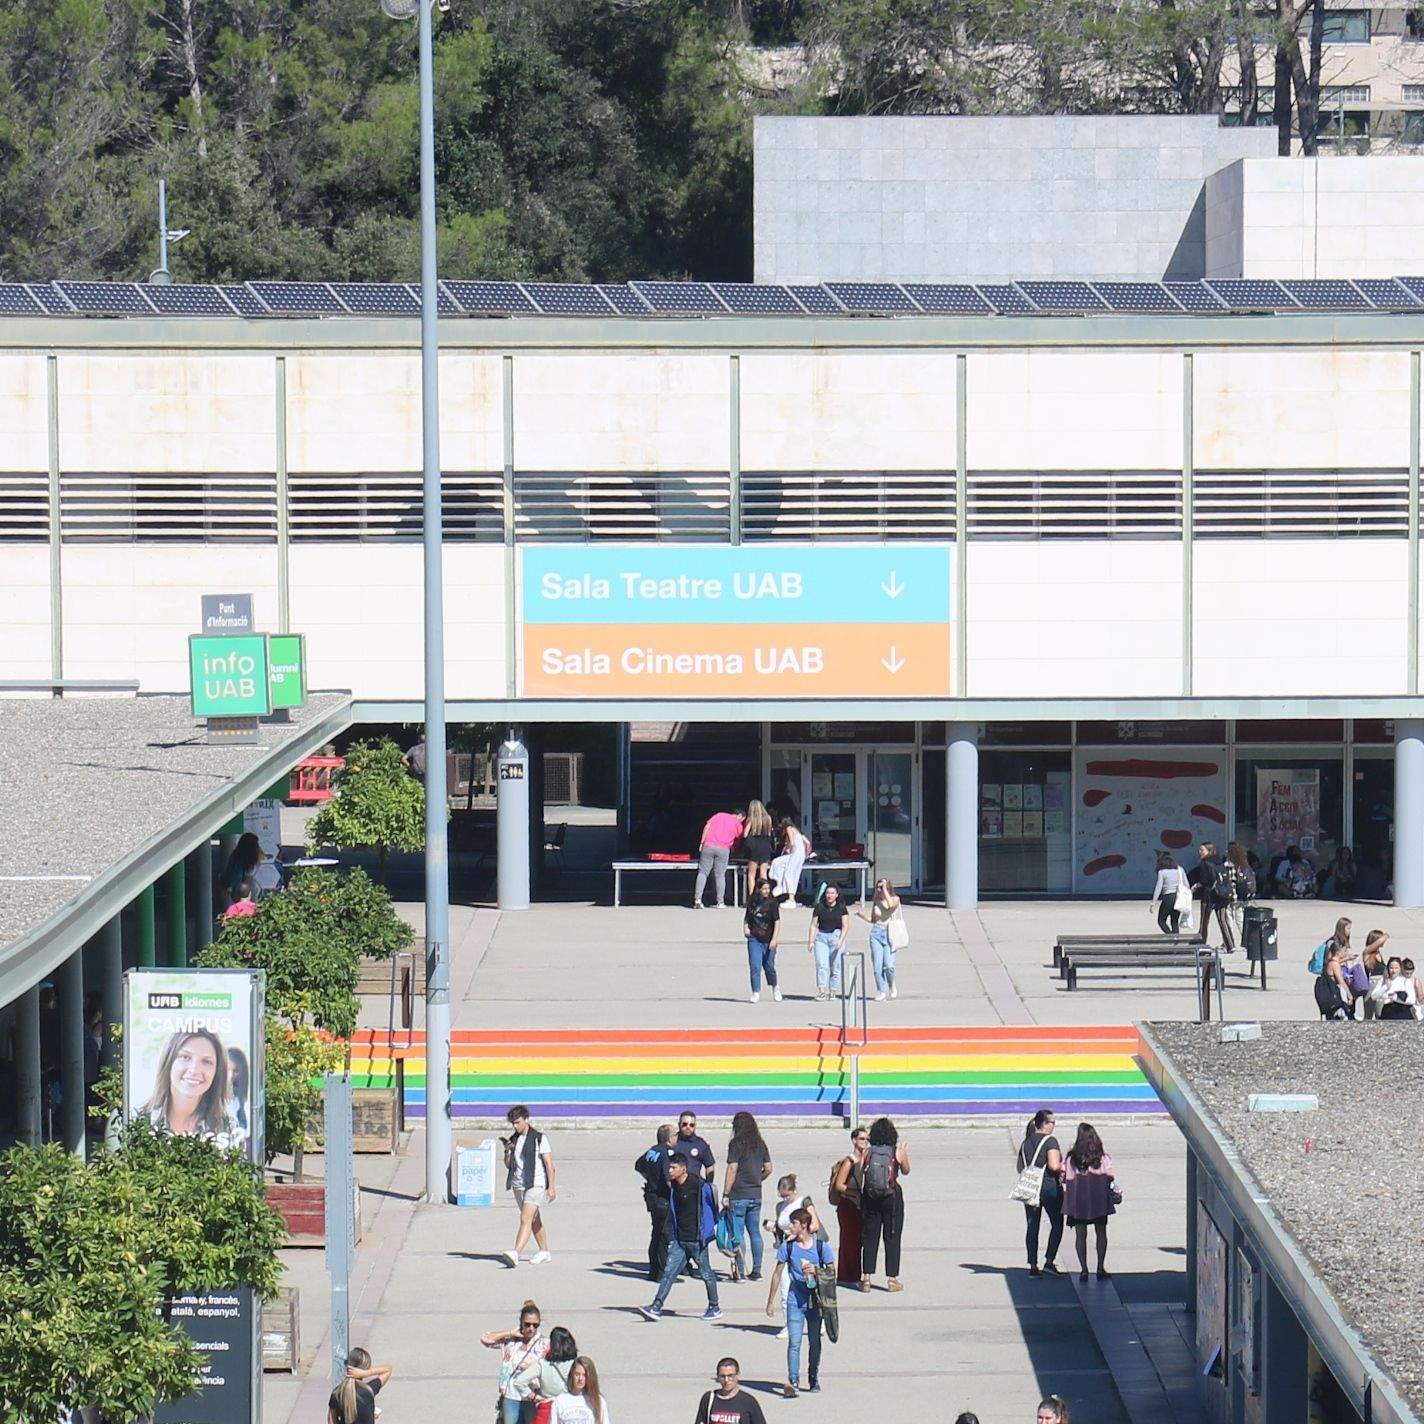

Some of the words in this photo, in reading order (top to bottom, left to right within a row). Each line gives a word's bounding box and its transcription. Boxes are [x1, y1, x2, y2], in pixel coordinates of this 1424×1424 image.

[540, 572, 611, 600] Sala
[619, 572, 723, 600] Teatre
[732, 572, 805, 600] UAB
[219, 602, 235, 614] Punt
[206, 615, 249, 628] d'Informació
[203, 651, 256, 676] info
[541, 647, 612, 675] Sala
[620, 647, 744, 675] Cinema
[753, 647, 825, 675] UAB
[269, 663, 299, 674] lumni
[269, 673, 285, 683] AB
[204, 678, 257, 700] UAB
[150, 995, 180, 1008] UAB
[183, 995, 230, 1009] idiomes
[147, 1016, 233, 1034] CAMPUS
[462, 1166, 488, 1176] paper
[170, 1306, 196, 1317] atalà,
